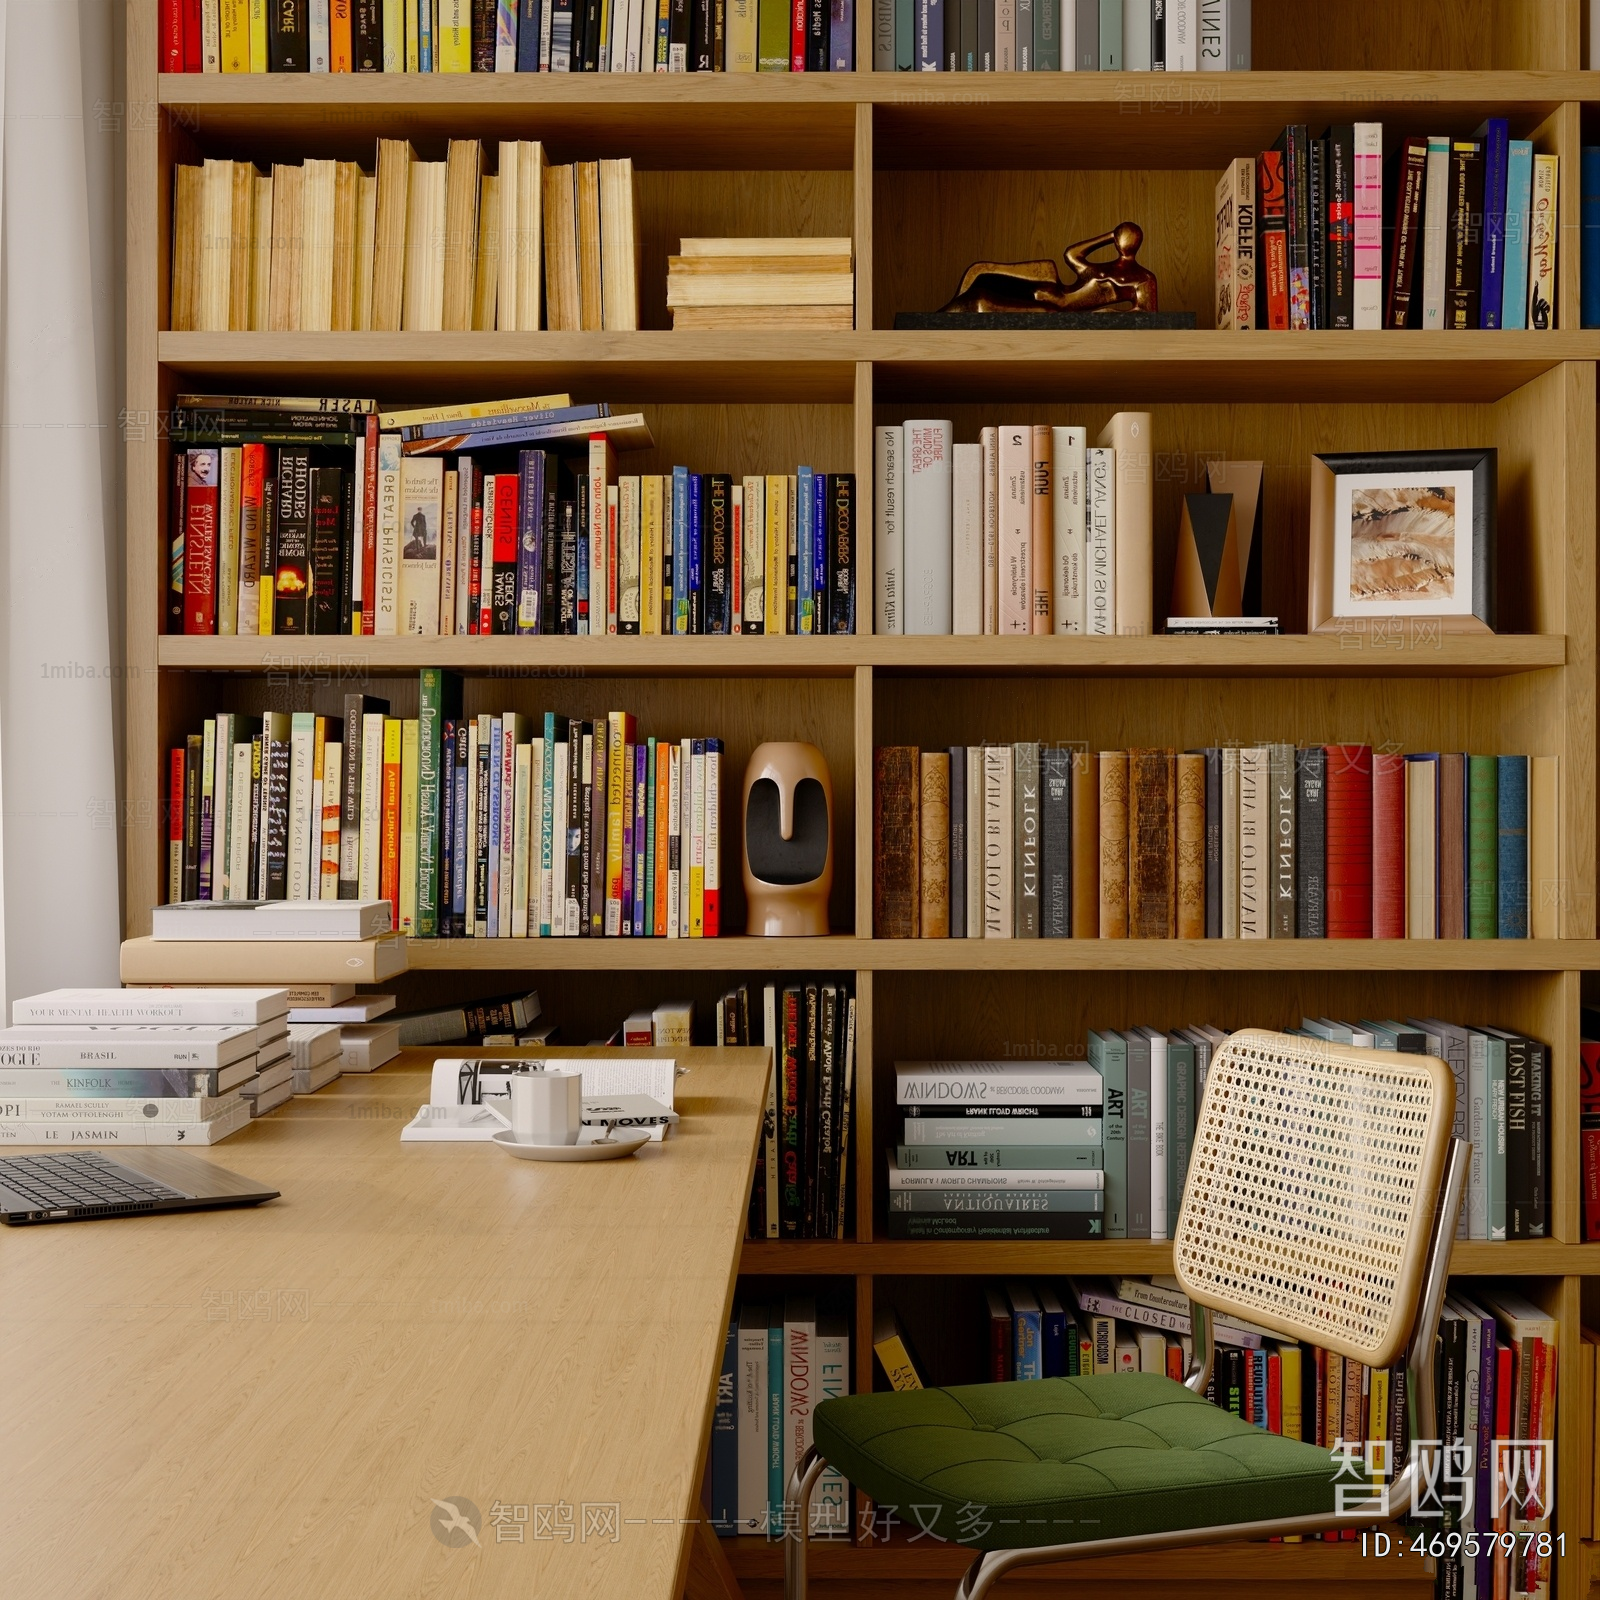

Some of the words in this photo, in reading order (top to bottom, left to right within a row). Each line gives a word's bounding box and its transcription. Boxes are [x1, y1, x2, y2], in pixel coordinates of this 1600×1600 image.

[30, 1009, 55, 1017] YOUR
[58, 1009, 94, 1017] MENTAL
[136, 1009, 184, 1017] WORKOUT
[1509, 1043, 1525, 1088] LOST
[1530, 1052, 1541, 1101] MAKING
[67, 1079, 112, 1088] KINFOLK
[1108, 1088, 1123, 1119] ART
[1131, 1088, 1147, 1119] ART
[1473, 1097, 1483, 1137] Gardens
[1509, 1092, 1525, 1131] FISH
[1530, 1103, 1541, 1116] IT
[46, 1131, 59, 1139] LE
[72, 1130, 118, 1140] JASMIN
[1474, 1139, 1483, 1149] in
[1497, 1123, 1505, 1154] HOUSING
[1473, 1151, 1483, 1184] France
[1124, 1307, 1176, 1328] CLOSED
[1096, 1321, 1109, 1365] MICROCOSM
